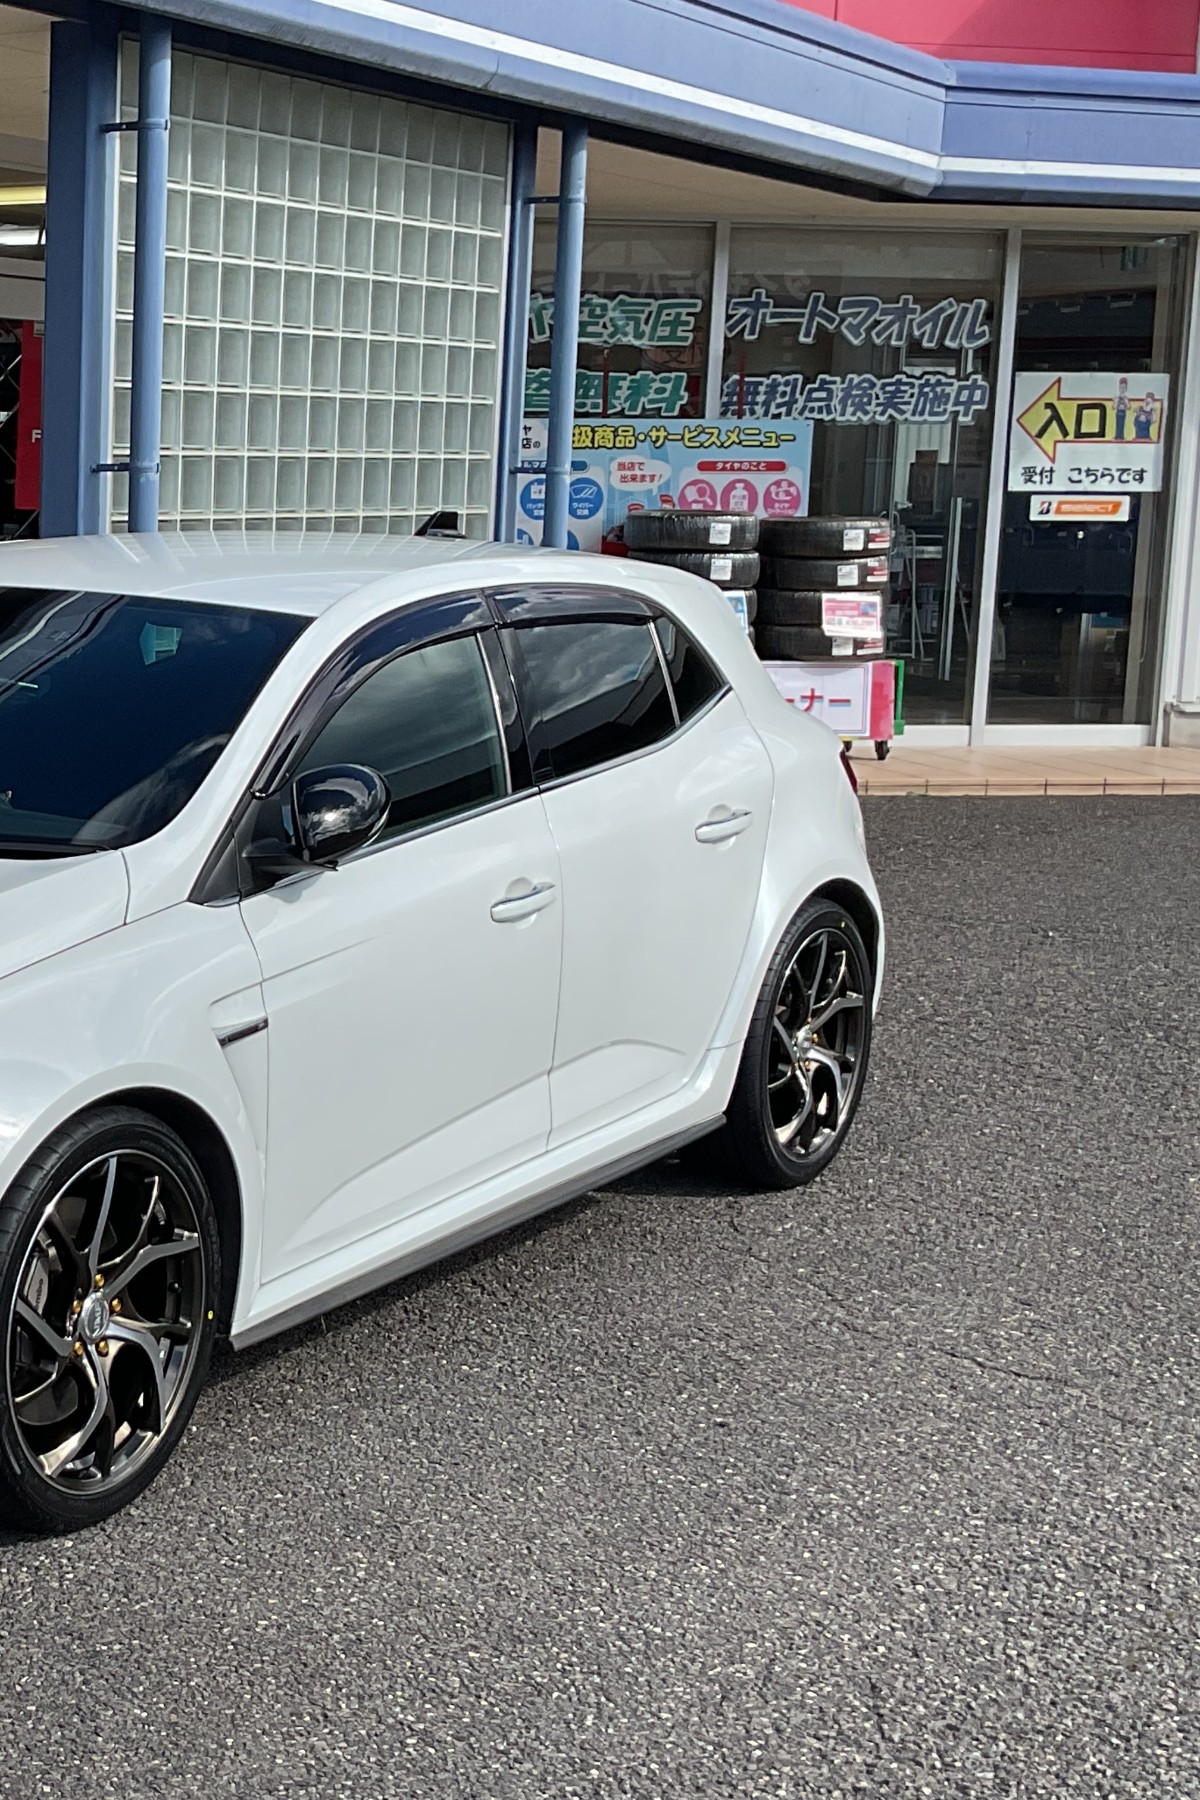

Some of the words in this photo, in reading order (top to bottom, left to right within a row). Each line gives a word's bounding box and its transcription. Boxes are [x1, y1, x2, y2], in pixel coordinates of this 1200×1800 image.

[725, 289, 991, 348] オートマオイル
[719, 373, 990, 422] 無料点検実施中
[1034, 402, 1107, 439] 入口
[617, 461, 645, 472] 当店で
[715, 461, 768, 471] タイヤのこと
[1021, 466, 1056, 485] 受付
[1067, 466, 1148, 485] こちらです
